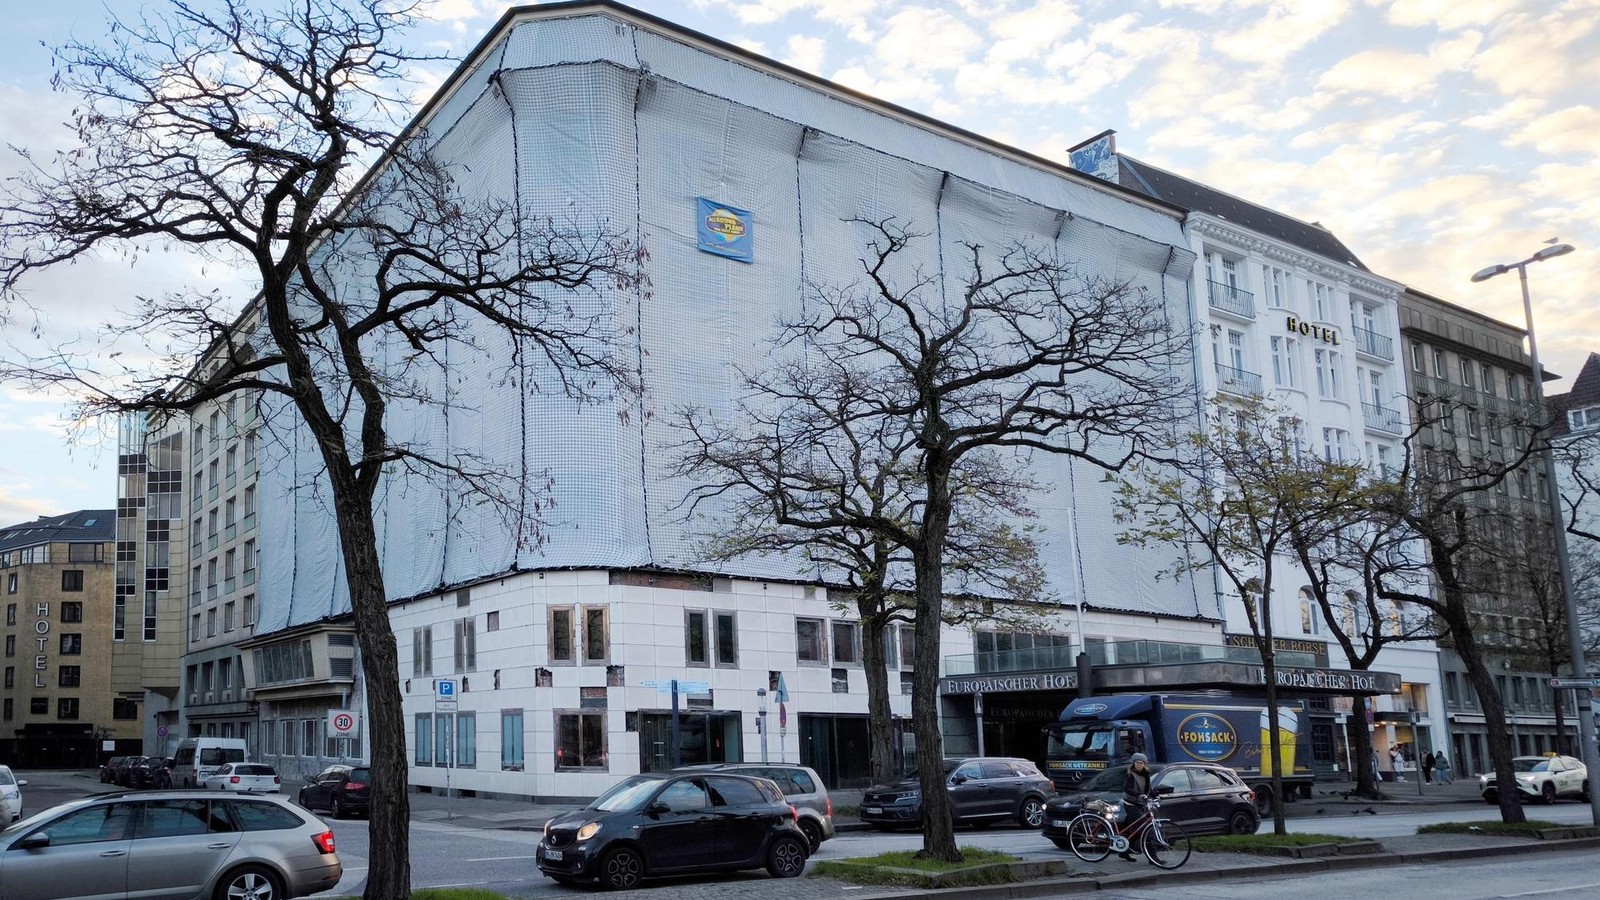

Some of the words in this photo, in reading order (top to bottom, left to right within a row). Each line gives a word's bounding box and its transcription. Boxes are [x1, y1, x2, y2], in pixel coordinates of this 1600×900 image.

[1287, 316, 1341, 346] HOTEL
[35, 602, 50, 687] HOTEL
[1233, 636, 1286, 651] SCHER
[947, 676, 1038, 693] EUROPÄISCHER
[1043, 674, 1073, 689] HOF
[1259, 667, 1346, 689] EROPÄISCHER
[1351, 674, 1376, 689] HOF
[442, 683, 450, 693] P
[338, 718, 348, 727] 30
[1184, 731, 1231, 743] FOHSACK
